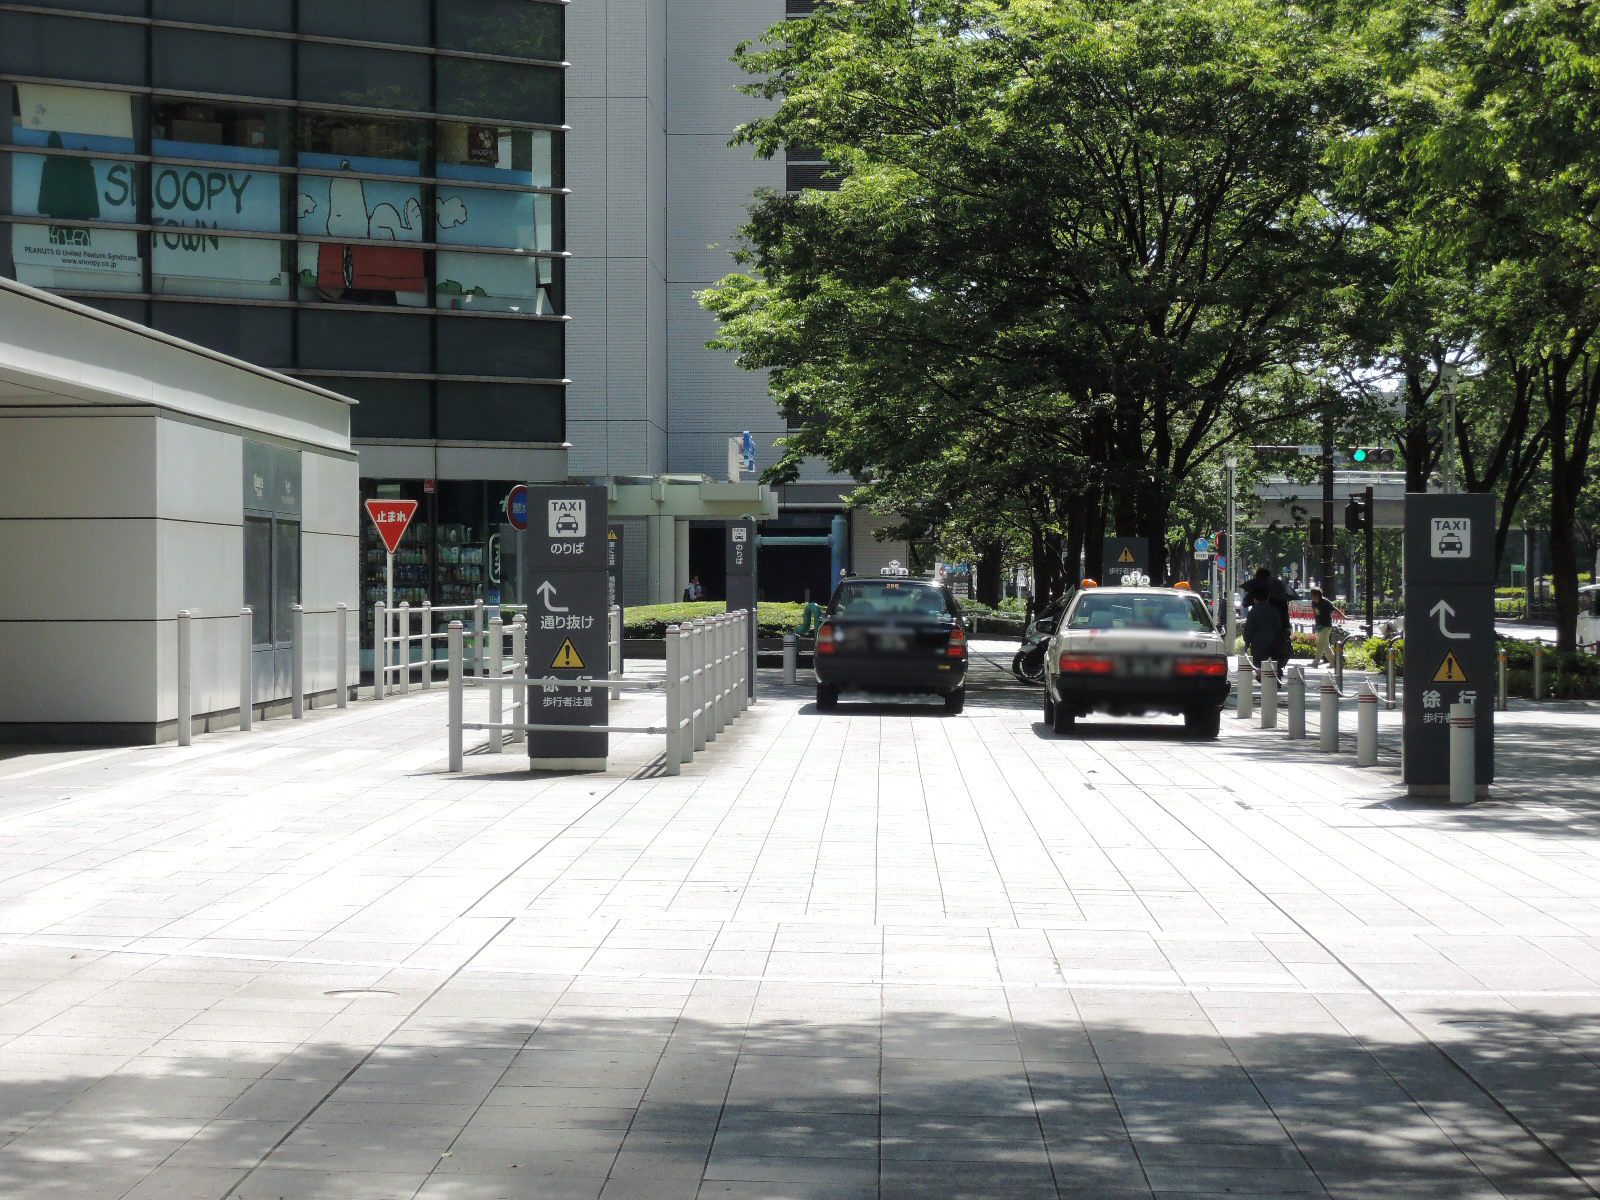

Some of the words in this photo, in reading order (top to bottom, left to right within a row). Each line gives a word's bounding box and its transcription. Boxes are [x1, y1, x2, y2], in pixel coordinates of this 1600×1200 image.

[24, 246, 55, 256] PEANUTS
[83, 251, 106, 260] Feature
[107, 253, 137, 262] Syndicate
[61, 258, 117, 268] www.snoopy.co.jp
[552, 501, 582, 511] TAXI
[376, 510, 407, 523] 止まれ
[1435, 520, 1467, 531] TAXI
[551, 542, 585, 555] のりば
[735, 543, 743, 565] のりば
[540, 615, 595, 630] 通り抜け
[542, 696, 593, 708] 歩行者注意
[1422, 712, 1451, 724] 歩行者
